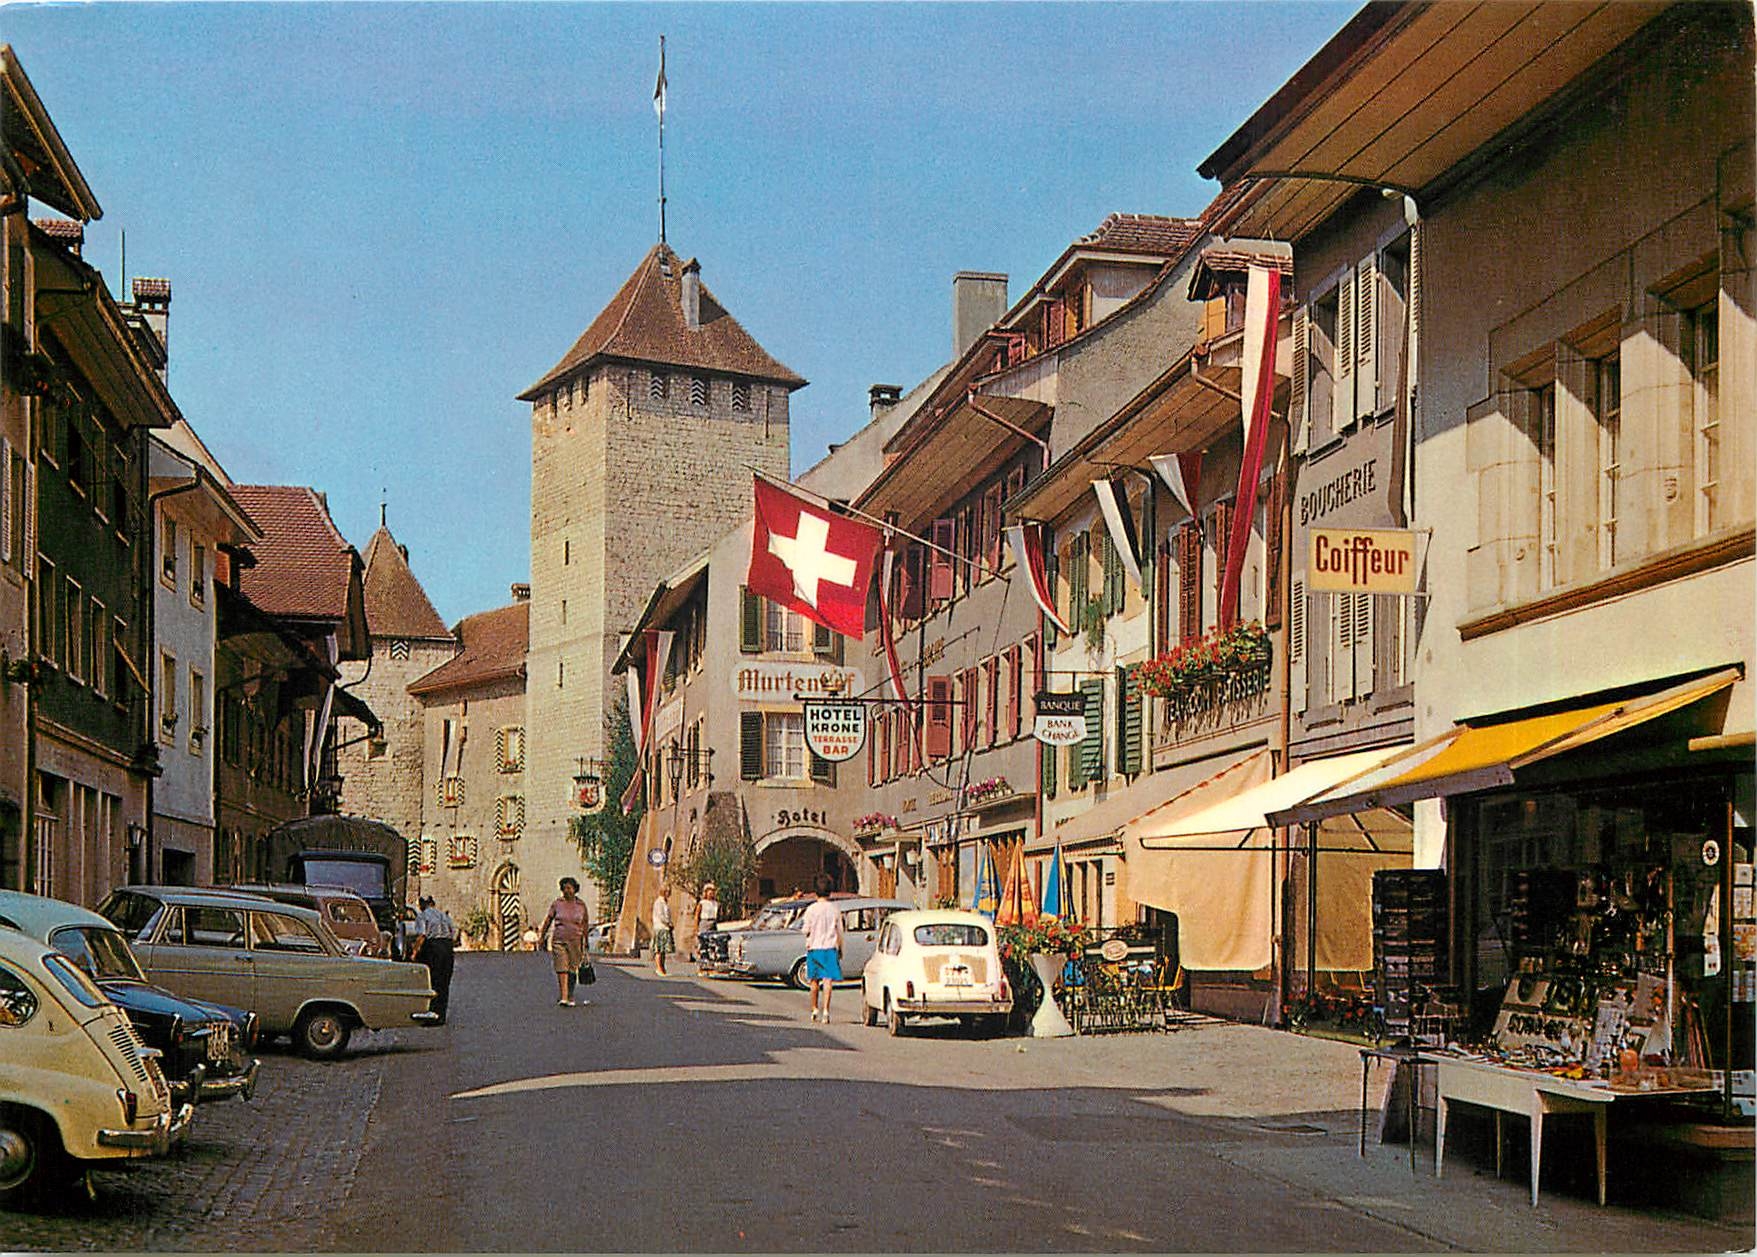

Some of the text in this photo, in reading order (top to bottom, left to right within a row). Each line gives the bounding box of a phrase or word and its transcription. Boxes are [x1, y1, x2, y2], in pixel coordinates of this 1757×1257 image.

[1301, 459, 1377, 526] BOUCHERIE
[1316, 535, 1409, 585] Coiffeur
[738, 668, 857, 698] Murtenf
[1040, 701, 1080, 711] BANQUE
[810, 709, 861, 721] HOTEL
[811, 722, 859, 733] KRONE
[1047, 720, 1072, 729] BANK
[1042, 728, 1080, 740] CHANGE
[823, 745, 849, 755] BAR
[777, 808, 826, 825] Hotel
